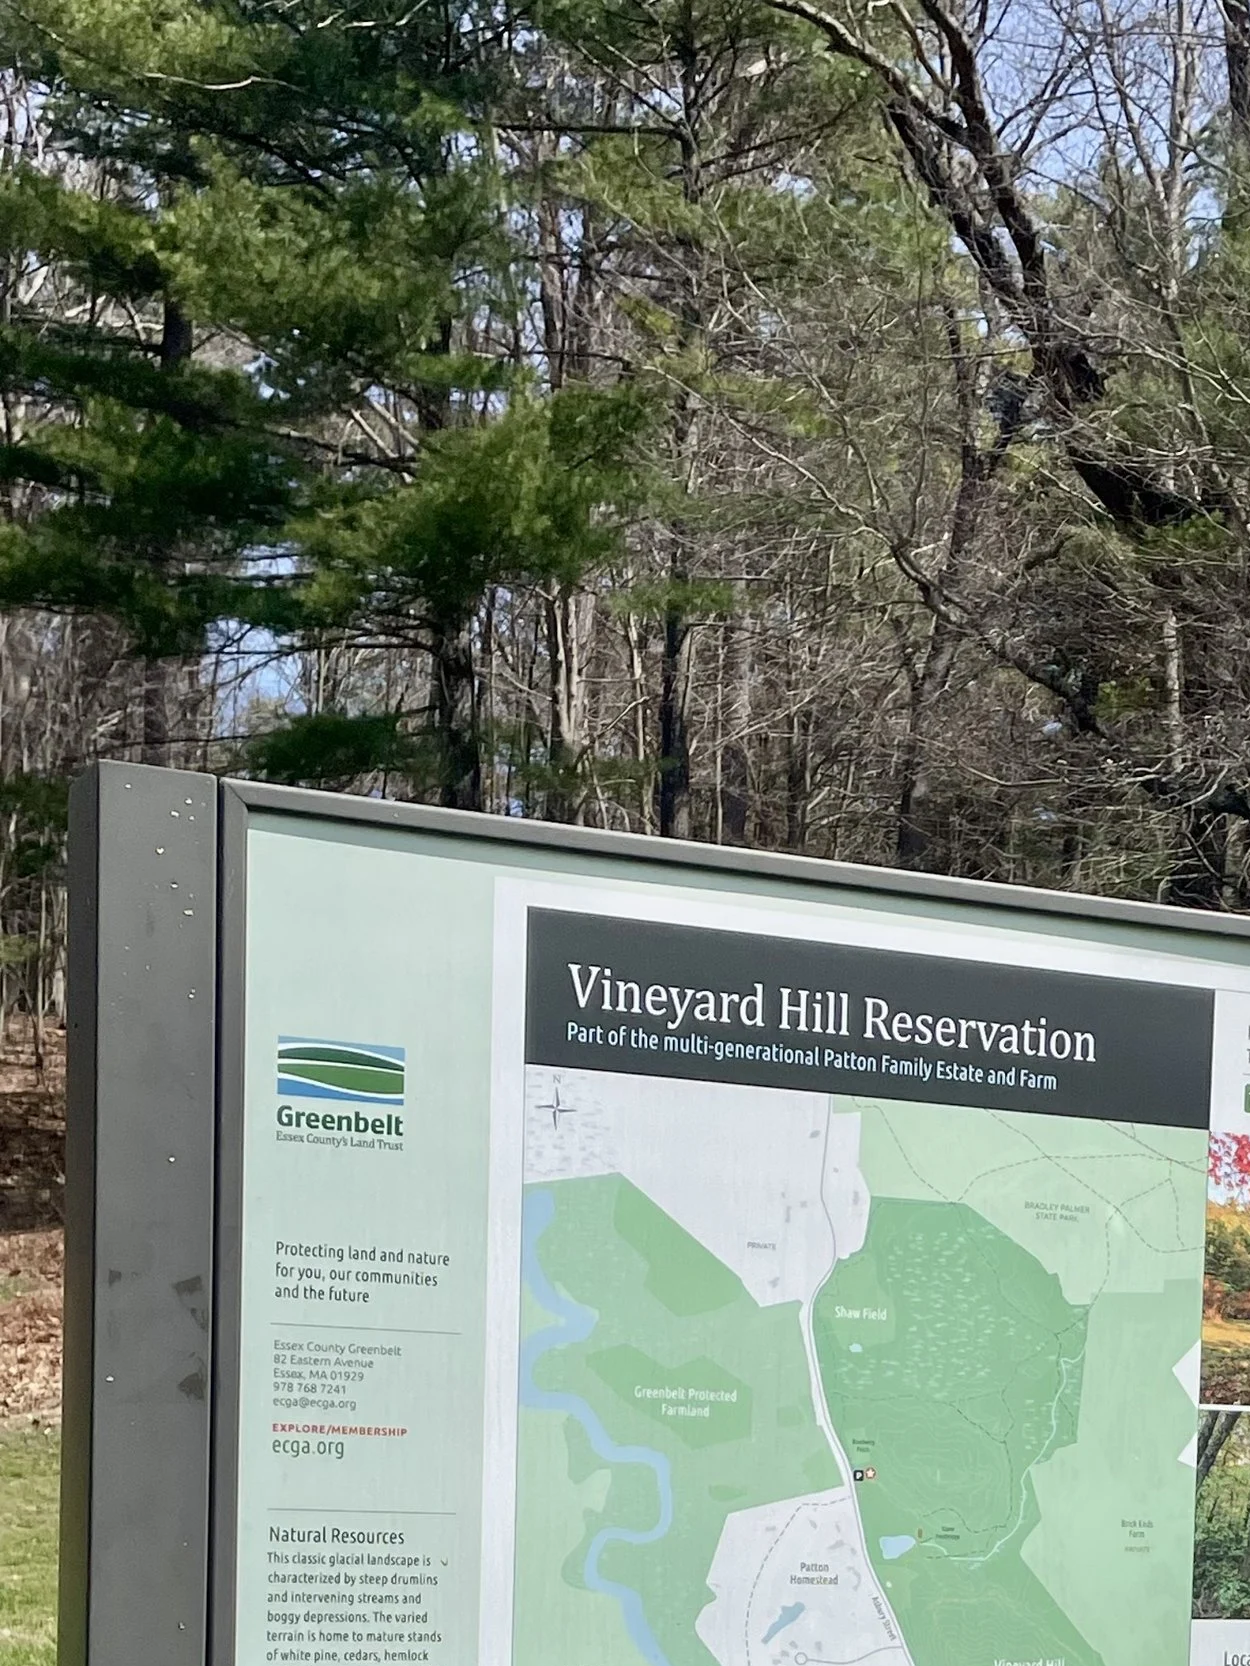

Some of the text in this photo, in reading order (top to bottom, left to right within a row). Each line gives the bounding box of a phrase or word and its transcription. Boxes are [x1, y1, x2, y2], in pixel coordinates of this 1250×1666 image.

[567, 963, 1097, 1062] Vineyard Hill Reservation
[568, 1023, 1057, 1089] Part of the multi-generational Patton Family Estate and Farm
[277, 1104, 404, 1136] Greenbelt
[276, 1240, 450, 1266] Protecting land and nature
[276, 1261, 438, 1286] for you, our communities
[275, 1283, 370, 1303] and the future
[835, 1305, 887, 1320] Shaw Field
[274, 1339, 402, 1356] Essex County Greenbelt
[273, 1353, 374, 1368] 82 Eastern Avenue
[273, 1367, 364, 1381] Essex, MA 01929
[273, 1381, 346, 1394] 978 768 7241
[634, 1385, 737, 1402] Greenbelt Protected
[272, 1396, 357, 1411] ecga@ecga.org
[661, 1403, 710, 1417] Farmland
[272, 1423, 407, 1436] EXPLORE/MEMBERSHIP
[272, 1439, 344, 1459] ecga.org
[270, 1525, 405, 1544] Natural Resources
[267, 1551, 431, 1568] This classic glacial landscape is
[800, 1561, 829, 1572] Patton
[790, 1574, 839, 1585] Homestead
